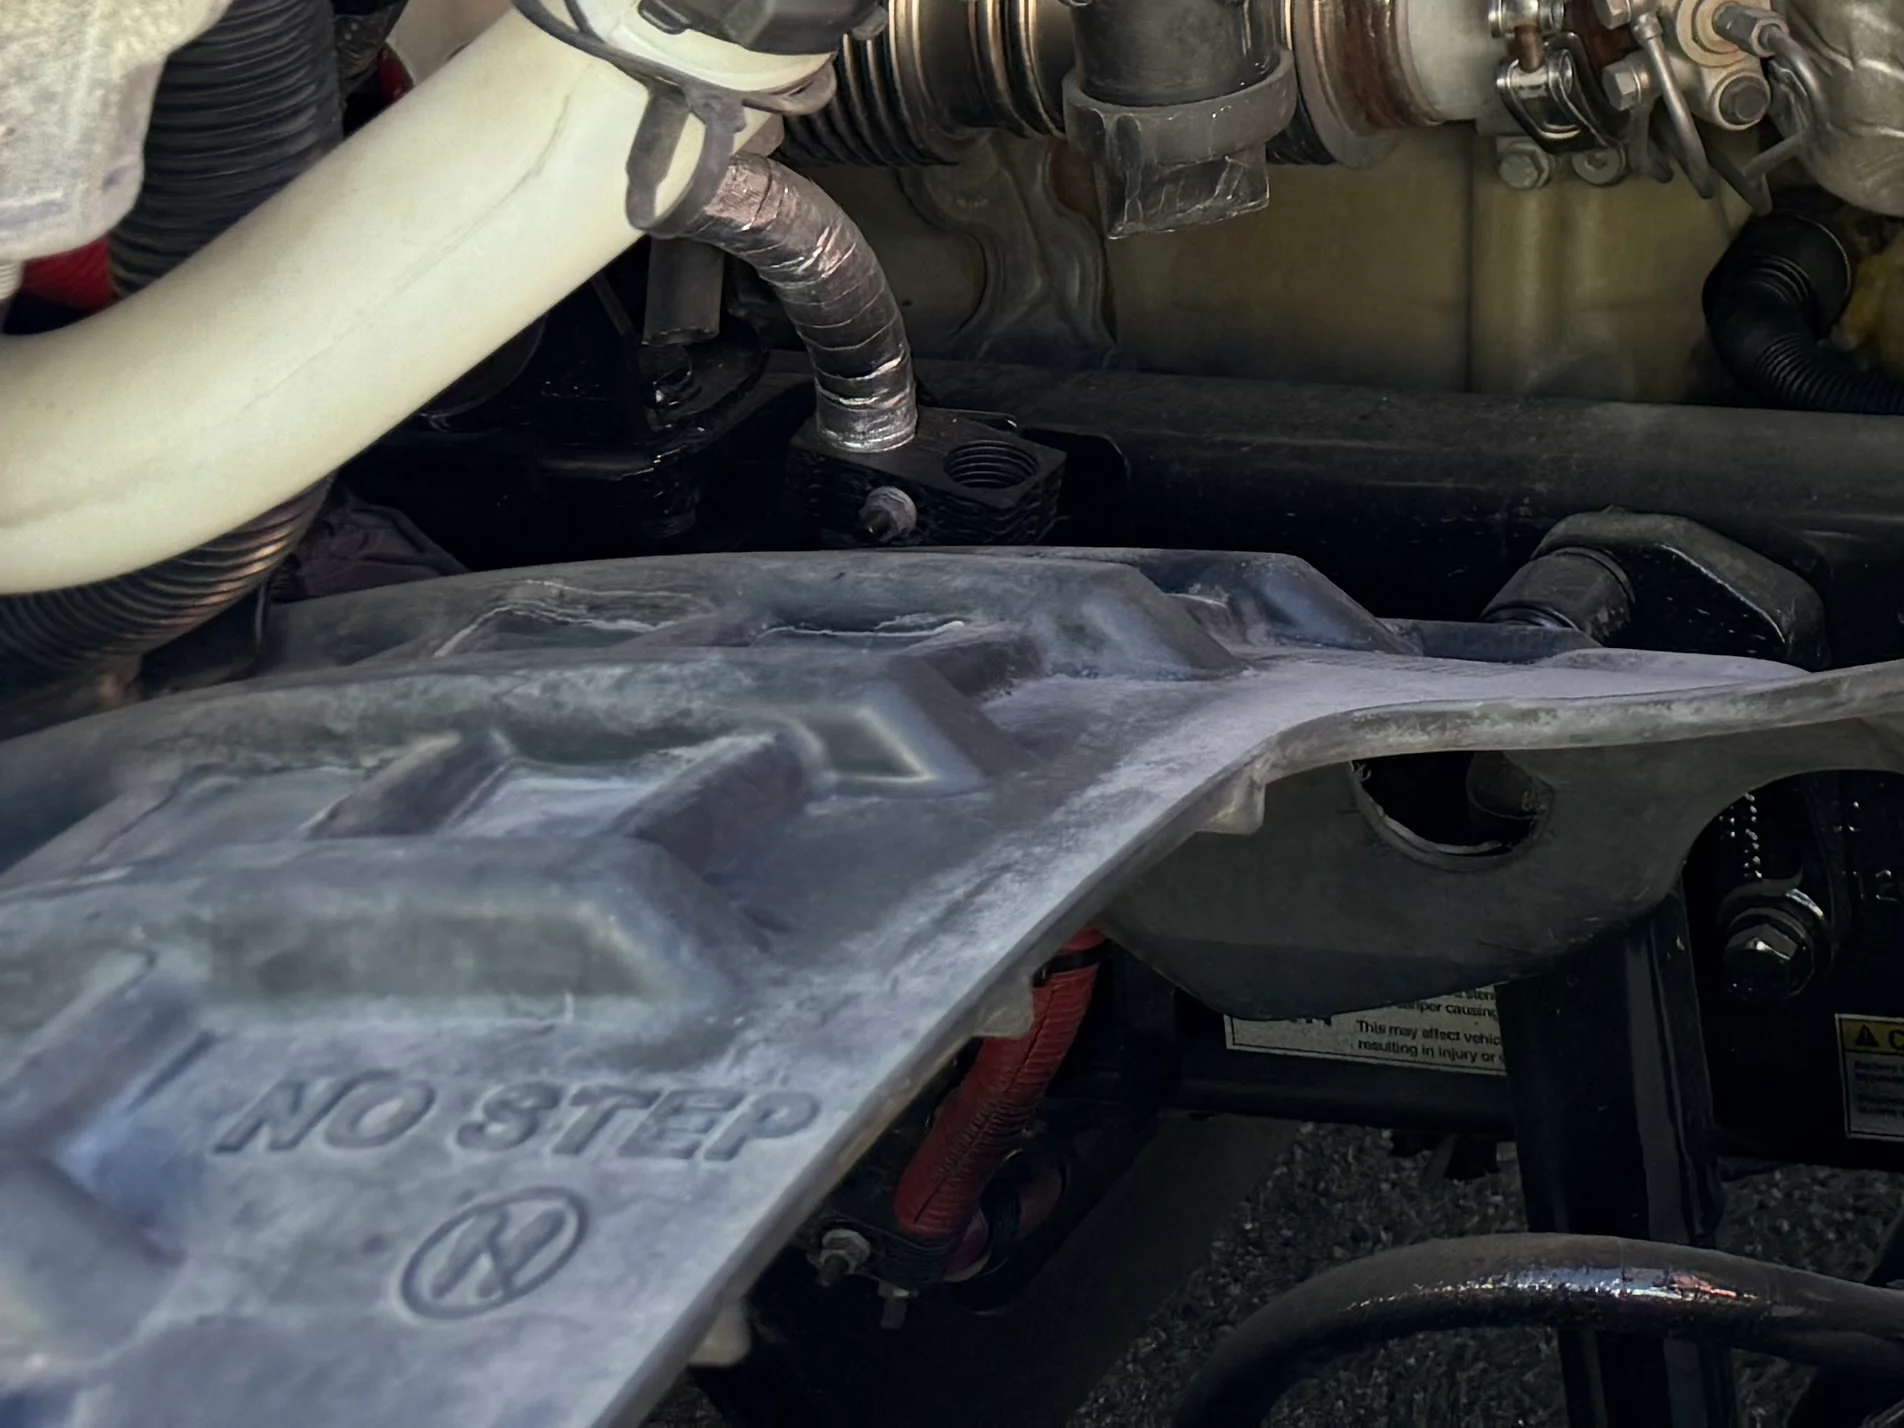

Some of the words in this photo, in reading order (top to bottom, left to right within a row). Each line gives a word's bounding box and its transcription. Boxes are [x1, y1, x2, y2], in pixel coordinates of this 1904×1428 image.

[1357, 1019, 1387, 1035] This
[1389, 1025, 1418, 1041] may
[1422, 1028, 1461, 1041] affect
[1357, 1039, 1418, 1057] resulting
[1422, 1046, 1434, 1058] in
[1439, 1047, 1477, 1063] injury
[1481, 1051, 1497, 1063] or
[212, 1070, 436, 1154] NO
[456, 1078, 822, 1162] STEP
